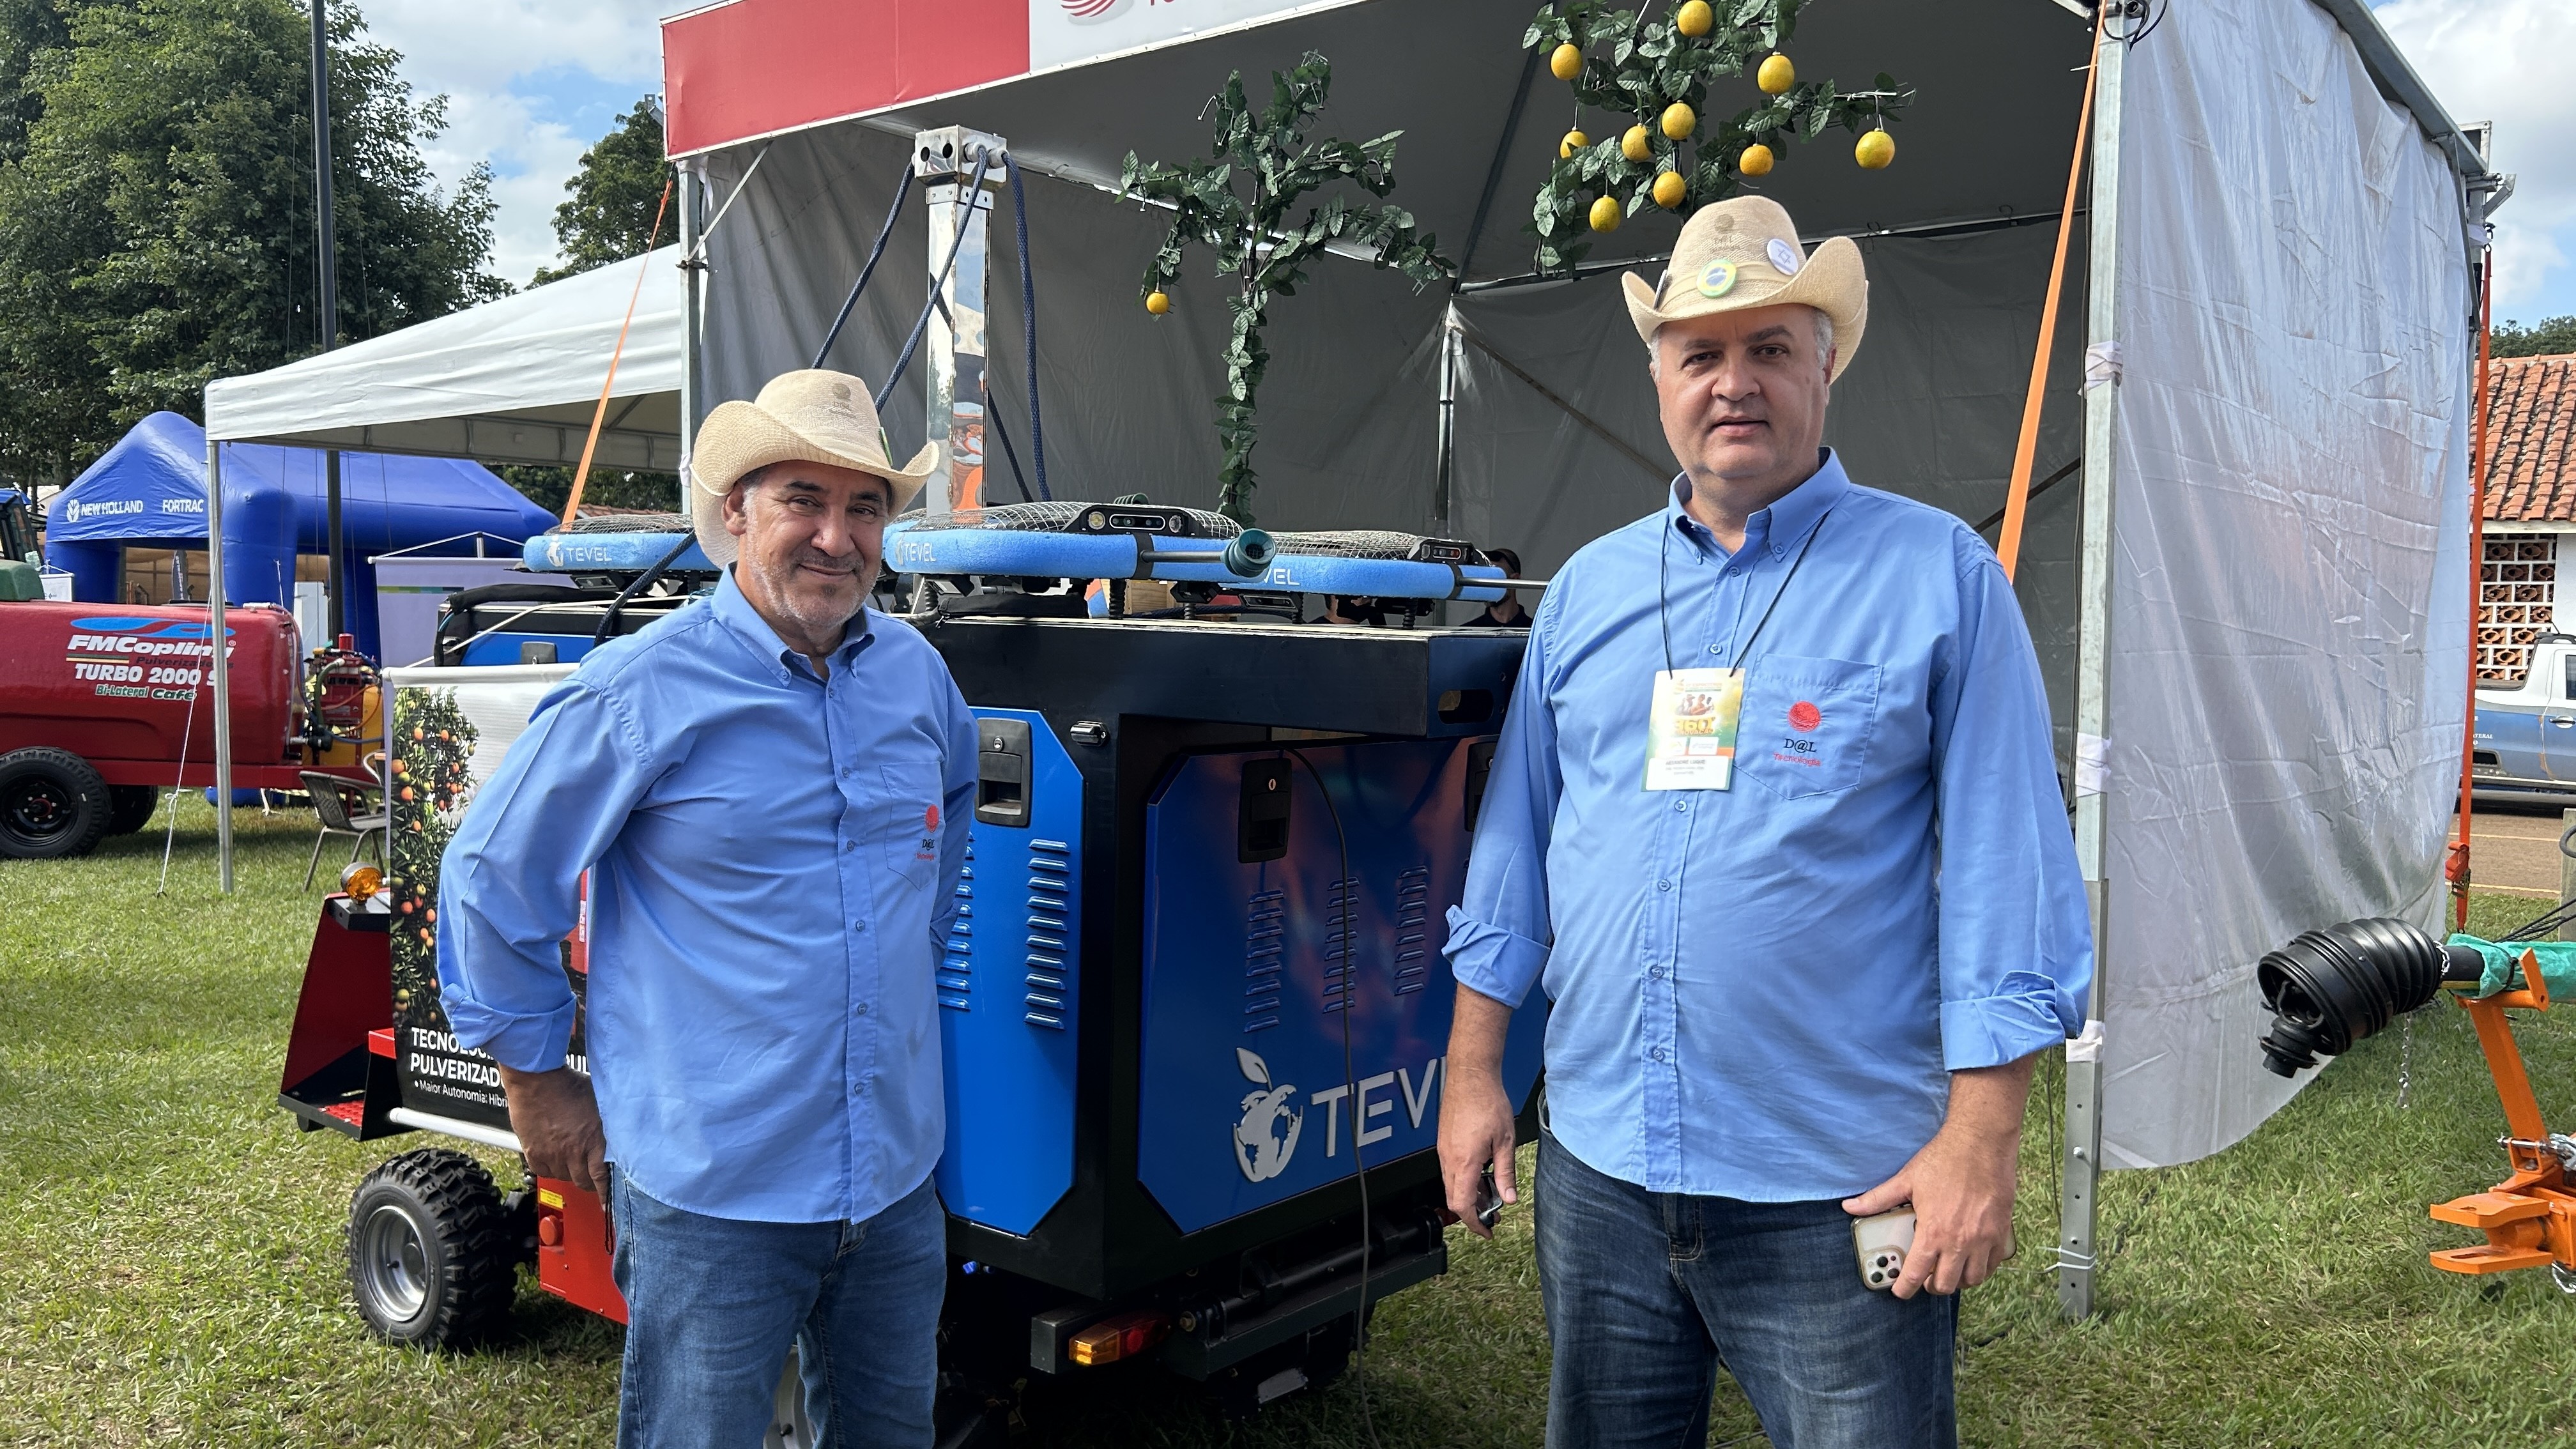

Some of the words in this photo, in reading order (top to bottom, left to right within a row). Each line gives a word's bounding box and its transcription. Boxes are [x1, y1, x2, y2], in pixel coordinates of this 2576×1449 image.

[81, 502, 101, 516] NEW
[102, 500, 143, 515] HOLLAND
[162, 499, 204, 513] FORTRAC
[566, 547, 613, 562] TEVEL
[904, 542, 937, 562] TEVEL
[75, 663, 143, 682] TURBO
[148, 667, 202, 686] 2000
[96, 684, 149, 698] Bi-Lateral
[1784, 738, 1817, 753] D@L
[410, 1052, 505, 1089] PULVERIZAD
[419, 1078, 441, 1094] Maior
[442, 1084, 488, 1104] Autonomia:
[1310, 1055, 1447, 1158] TEV
